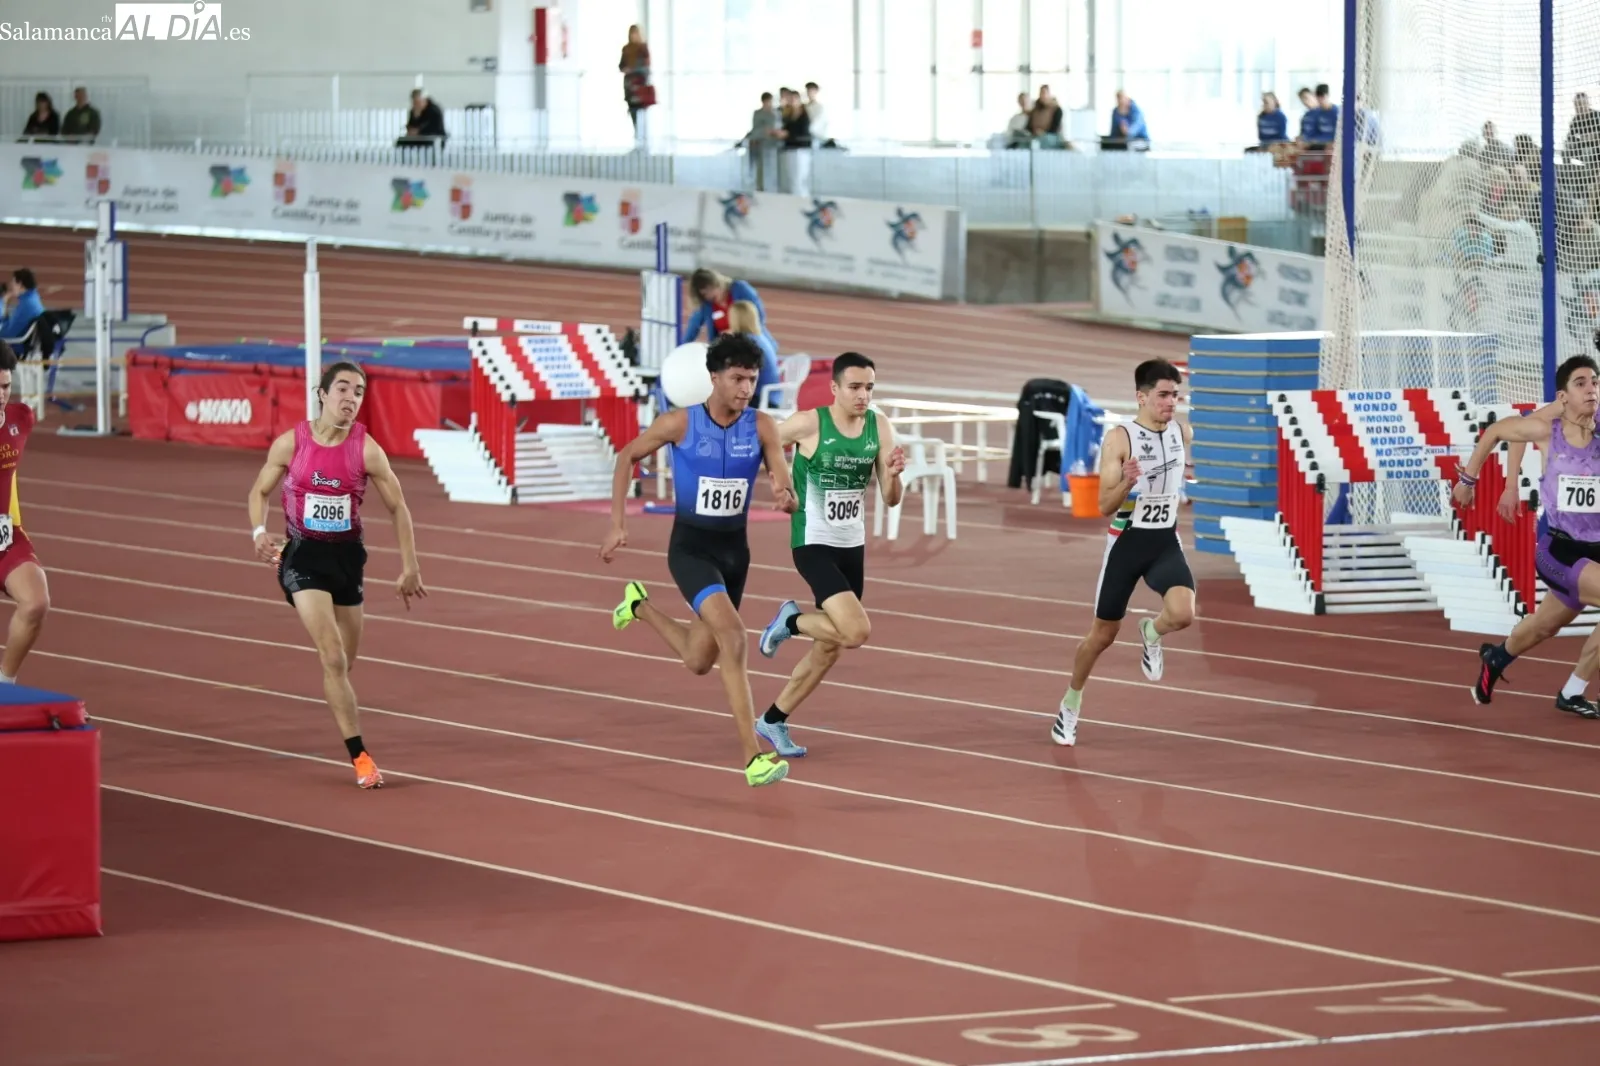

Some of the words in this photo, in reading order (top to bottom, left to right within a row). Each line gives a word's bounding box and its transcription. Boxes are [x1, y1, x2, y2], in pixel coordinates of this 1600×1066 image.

[1348, 391, 1392, 401] MONDO
[198, 398, 252, 424] MONDO
[1353, 402, 1397, 412] MONDO
[1366, 414, 1403, 424] MONDO
[1365, 425, 1406, 434] MONDO
[1370, 436, 1414, 446] MONDO
[1378, 458, 1423, 468] MONDO
[1386, 469, 1430, 480] MONDO
[701, 488, 742, 510] 1816
[1565, 487, 1596, 507] 706
[312, 504, 345, 520] 2096
[827, 499, 860, 521] 3096
[1141, 504, 1170, 523] 225
[961, 1022, 1141, 1049] 8
